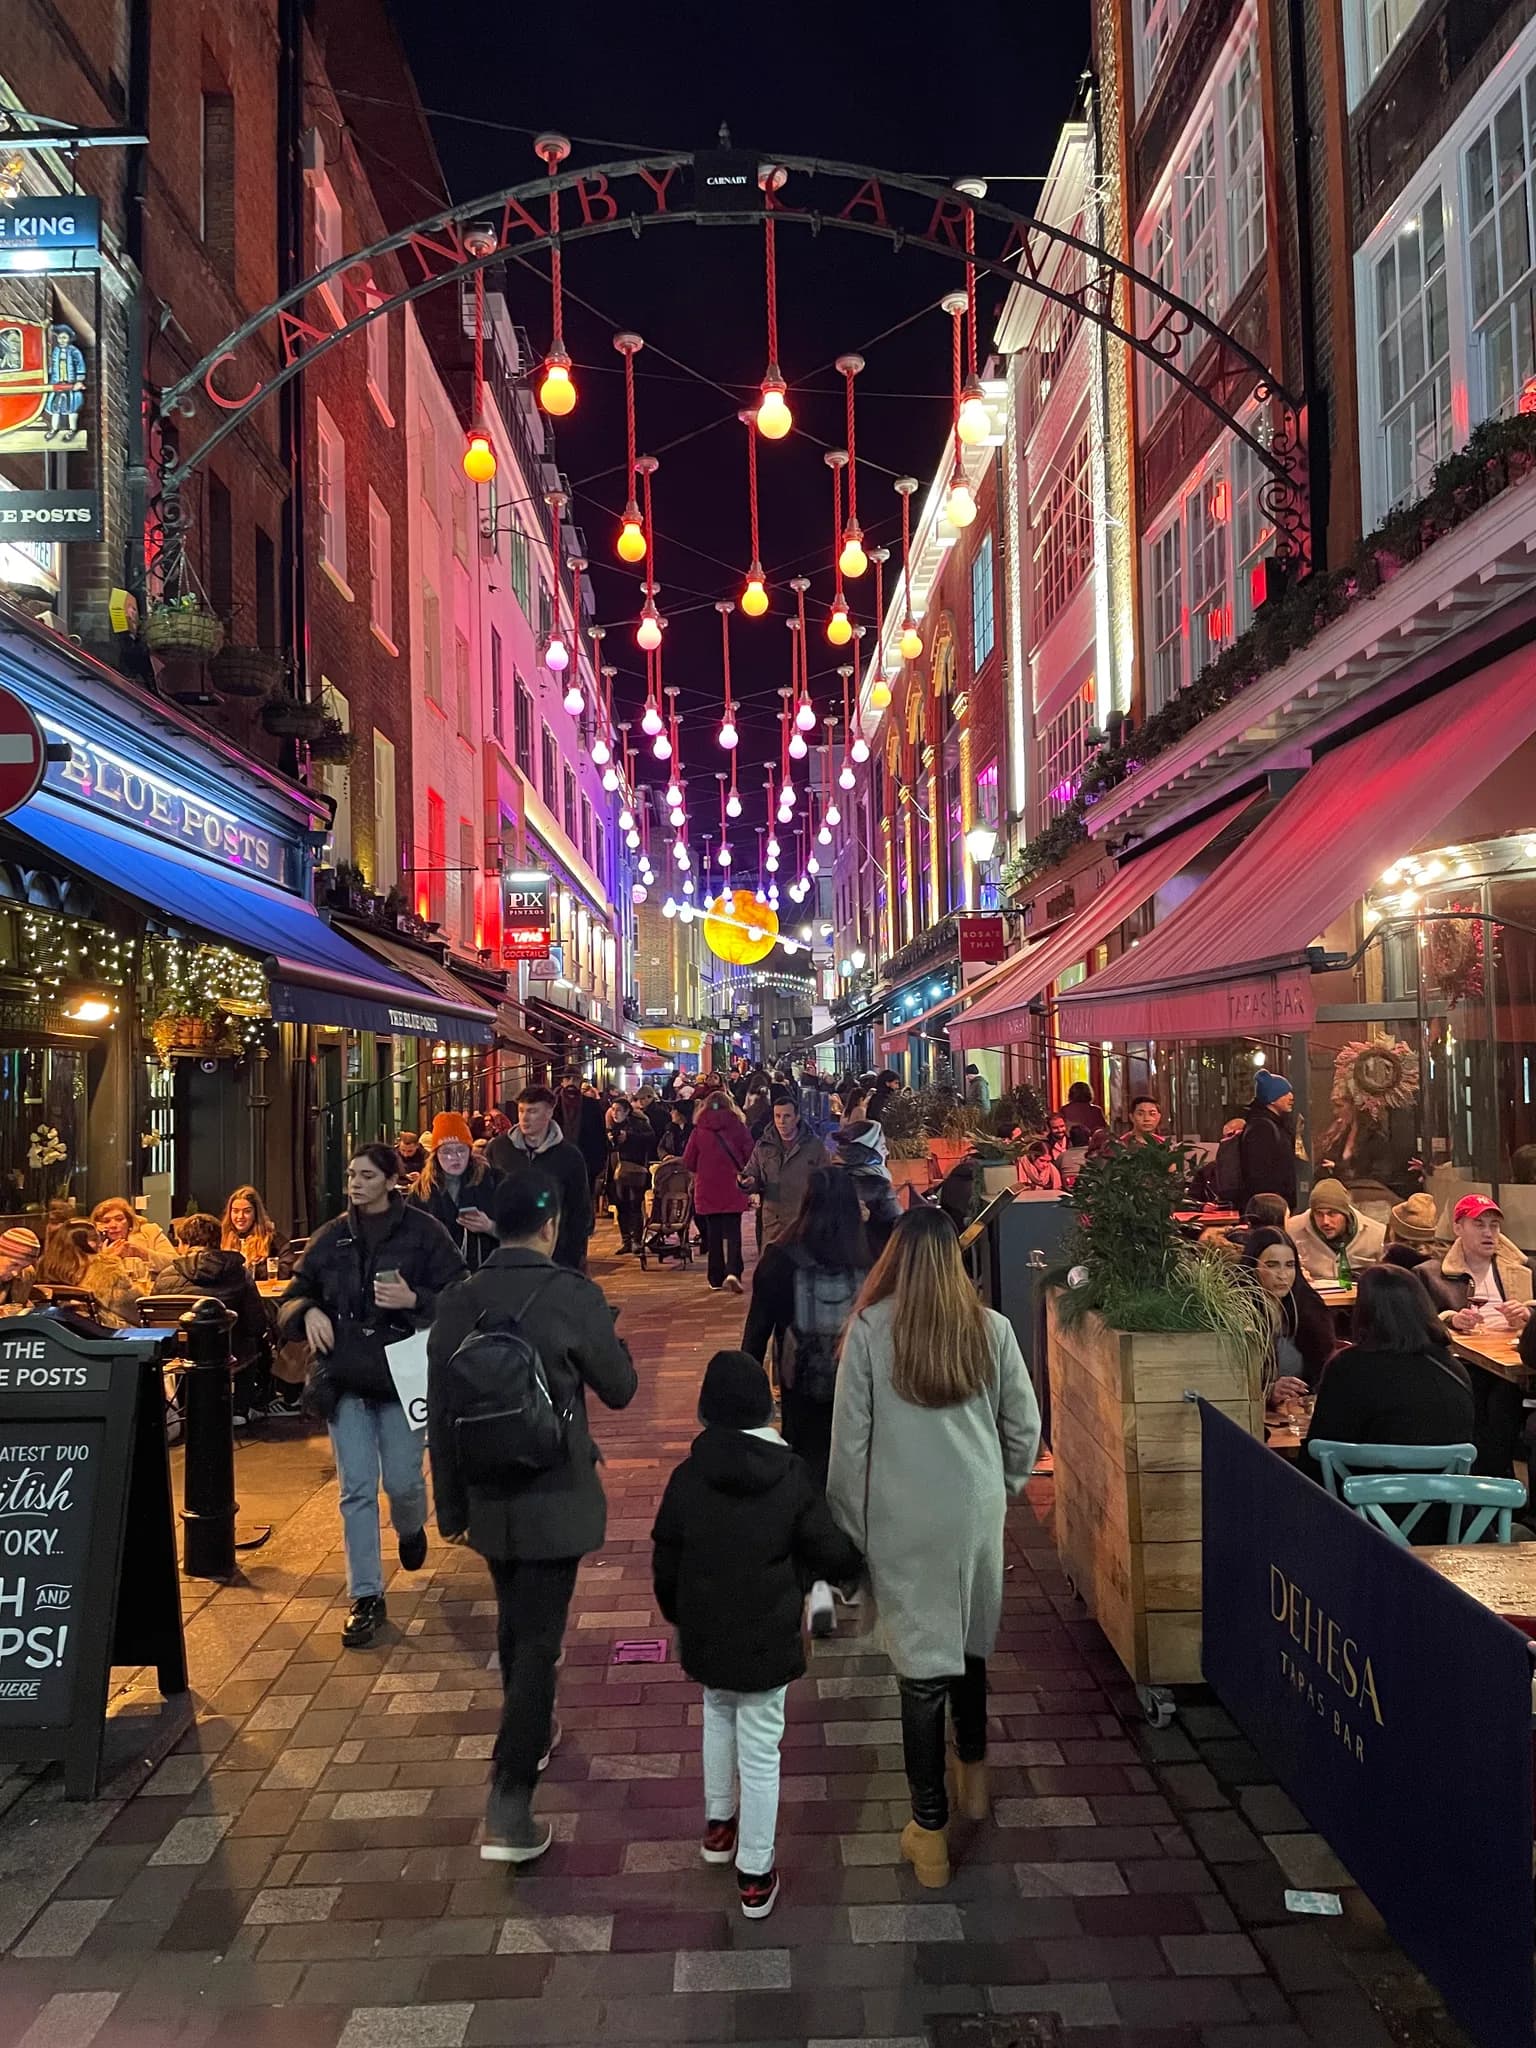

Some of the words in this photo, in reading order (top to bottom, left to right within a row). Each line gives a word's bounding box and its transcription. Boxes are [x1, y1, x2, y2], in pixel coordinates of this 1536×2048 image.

[706, 176, 748, 186] CARNABY
[14, 216, 76, 236] KING
[204, 167, 677, 409] CARNABY
[20, 508, 92, 523] POSTS
[61, 740, 173, 826] BLUE
[182, 800, 270, 869] POSTS
[509, 892, 544, 908] PIX
[511, 931, 545, 943] TAPAS
[963, 930, 1001, 938] ROSA'S
[970, 941, 995, 949] THAI
[504, 950, 548, 958] COCKTAILS
[1228, 991, 1267, 1020] TAPAS
[3, 1341, 46, 1360] THE
[16, 1367, 87, 1386] POSTS
[56, 1445, 89, 1461] DUO
[36, 1589, 70, 1606] AND
[1271, 1563, 1384, 1727] DEHESA
[1280, 1651, 1325, 1717] TAPAS
[1333, 1710, 1365, 1764] BAR
